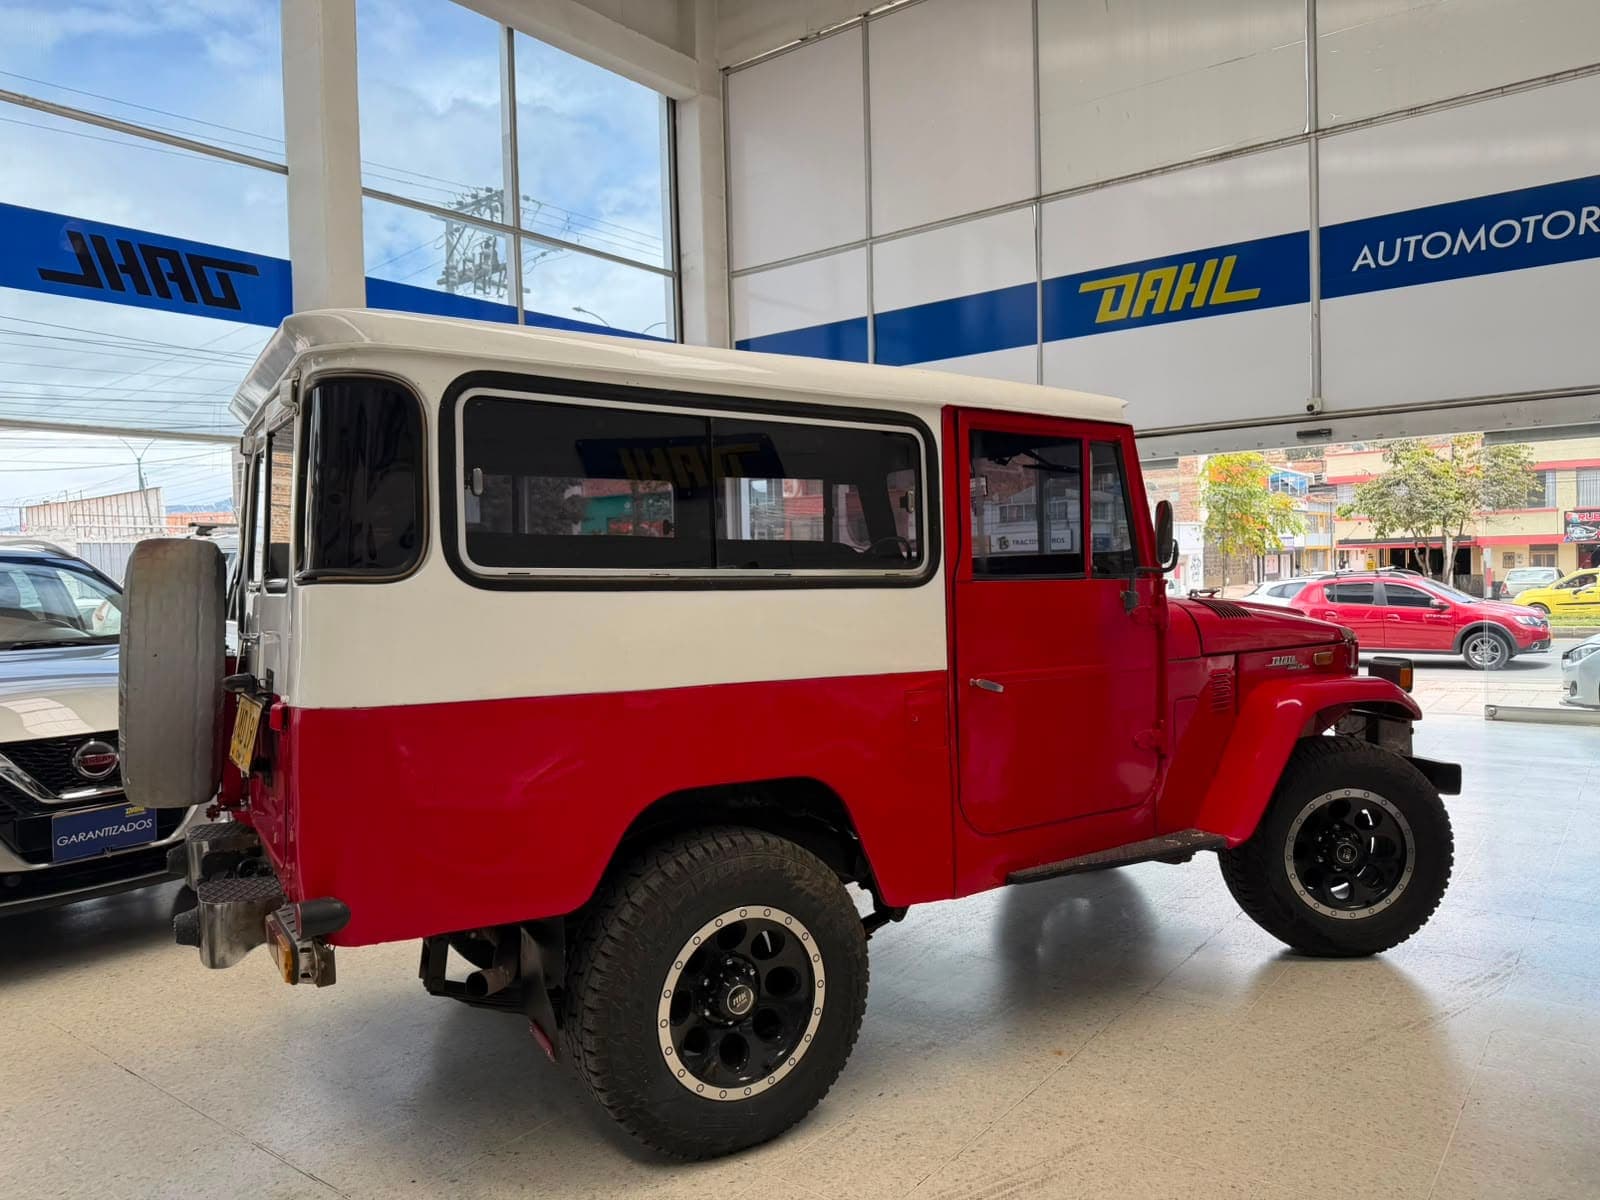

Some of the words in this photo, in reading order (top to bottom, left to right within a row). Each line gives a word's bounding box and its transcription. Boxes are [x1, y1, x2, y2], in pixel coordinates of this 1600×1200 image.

[1352, 206, 1600, 273] AUTOMOTOR
[1079, 254, 1262, 324] DAHL
[56, 818, 153, 846] GARANTIZADOS
